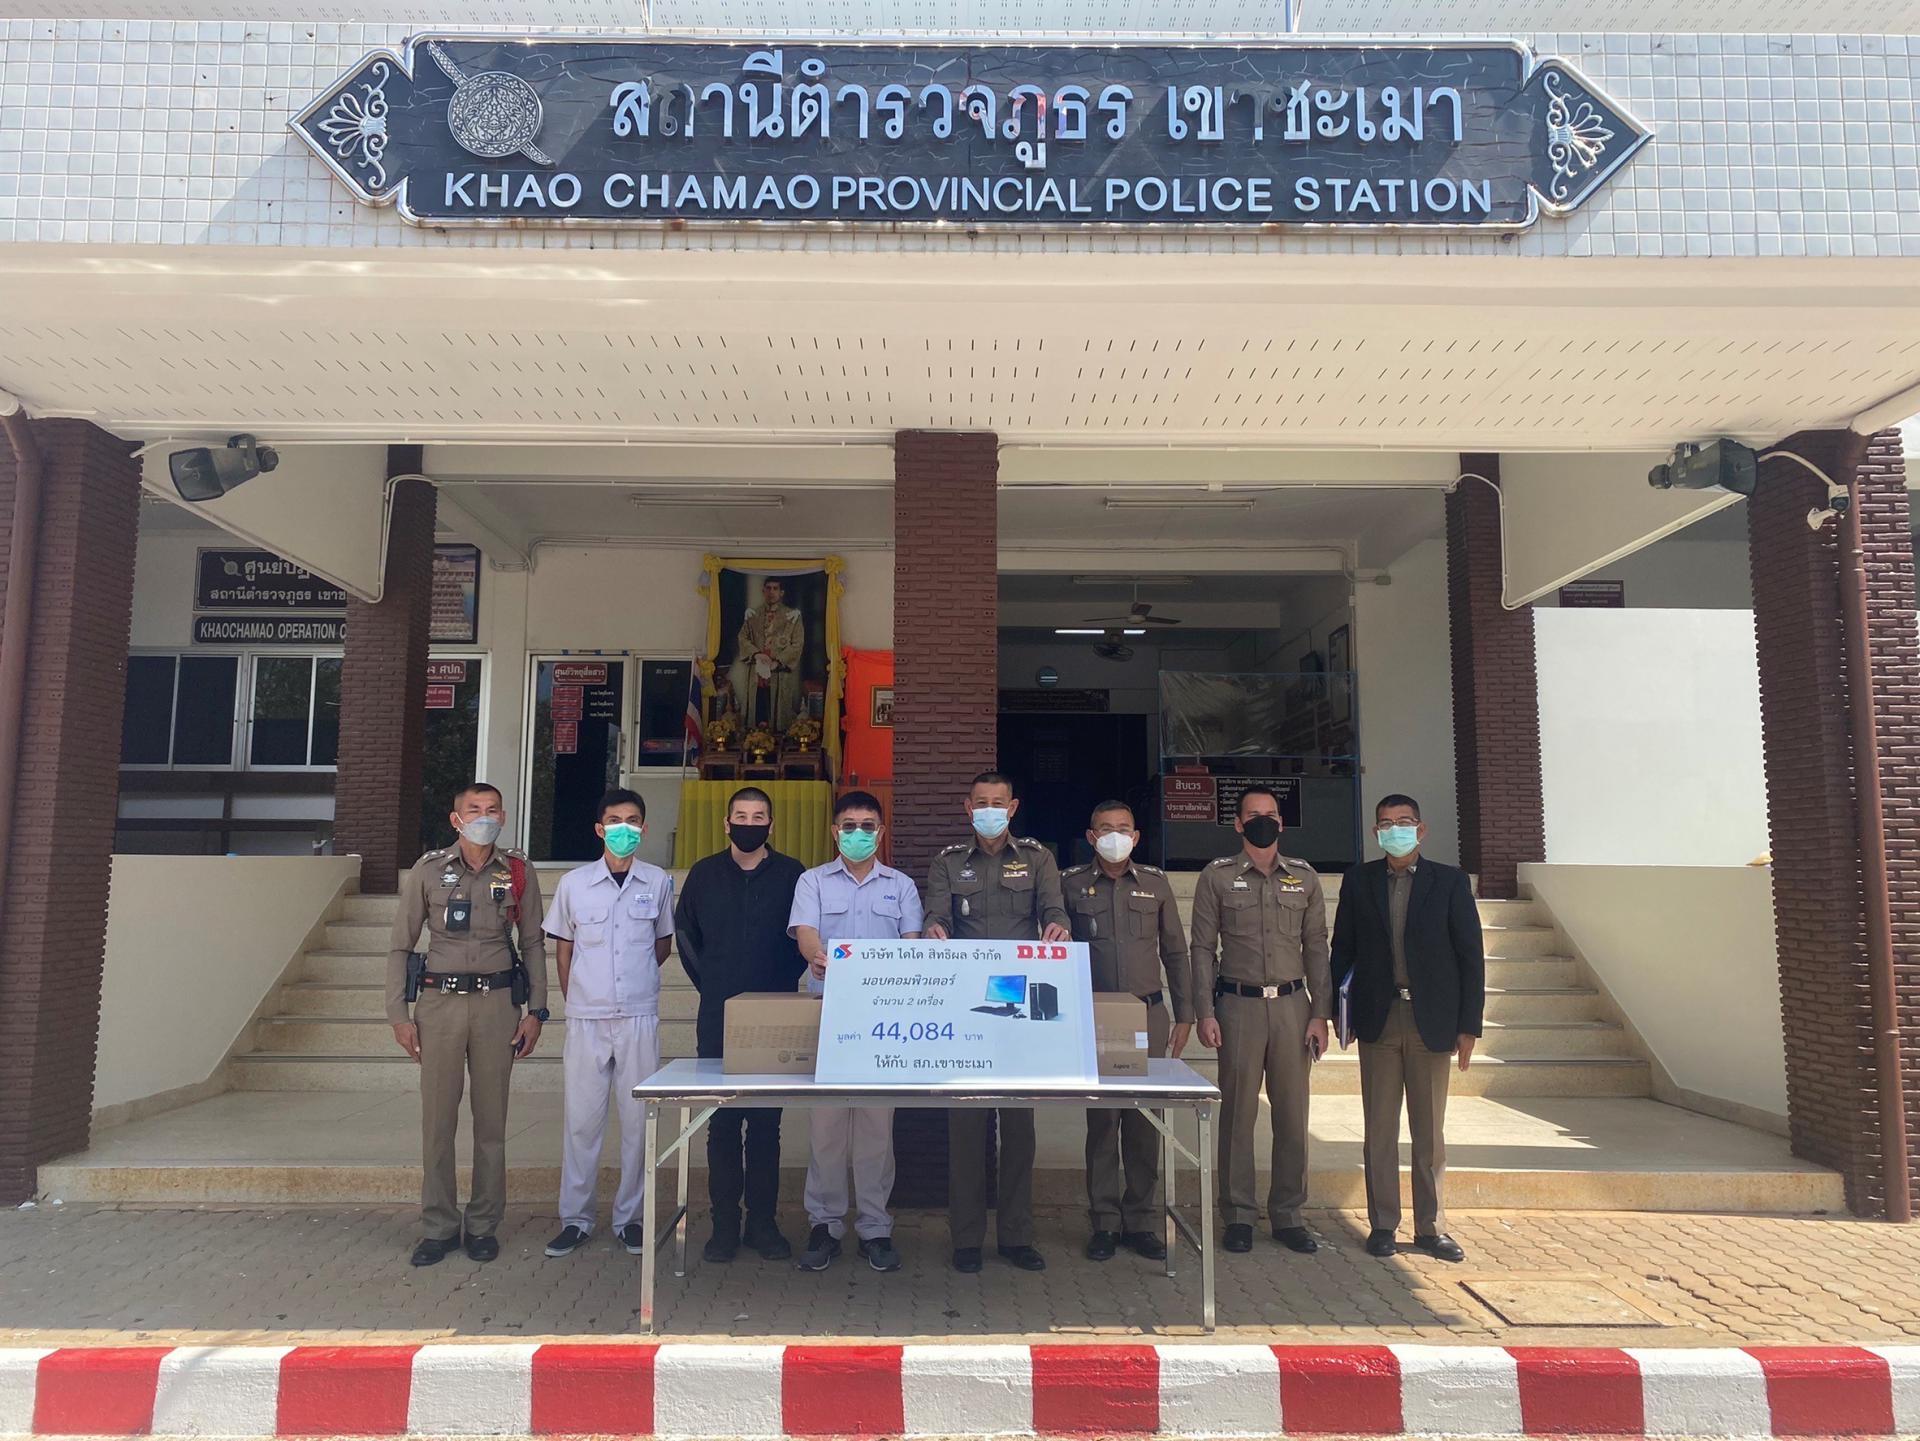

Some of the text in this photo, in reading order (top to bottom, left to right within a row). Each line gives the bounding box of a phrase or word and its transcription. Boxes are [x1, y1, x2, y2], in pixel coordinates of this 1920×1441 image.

[609, 49, 1463, 168] สถานีตำรวจภูธร เขาชะเมา
[444, 172, 1491, 214] KHAO CHAMAO PROVINCIAL POLICE STATION
[210, 586, 312, 605] สถานีตำรวจภูธร
[200, 622, 274, 639] KHAOCHAMAO
[277, 622, 336, 640] OPERATION
[861, 947, 894, 960] บริษัท
[897, 947, 924, 960] ไดโด
[971, 949, 1002, 961] จำกัด
[861, 973, 958, 986] มอบคอมพิวเตอร์
[872, 994, 944, 1006] จำนวน 2 เครื่อง
[836, 1021, 984, 1044] มูลค่า 44,084 บาท
[873, 1054, 993, 1069] ให้กับ สภ.เขาชะเมา
